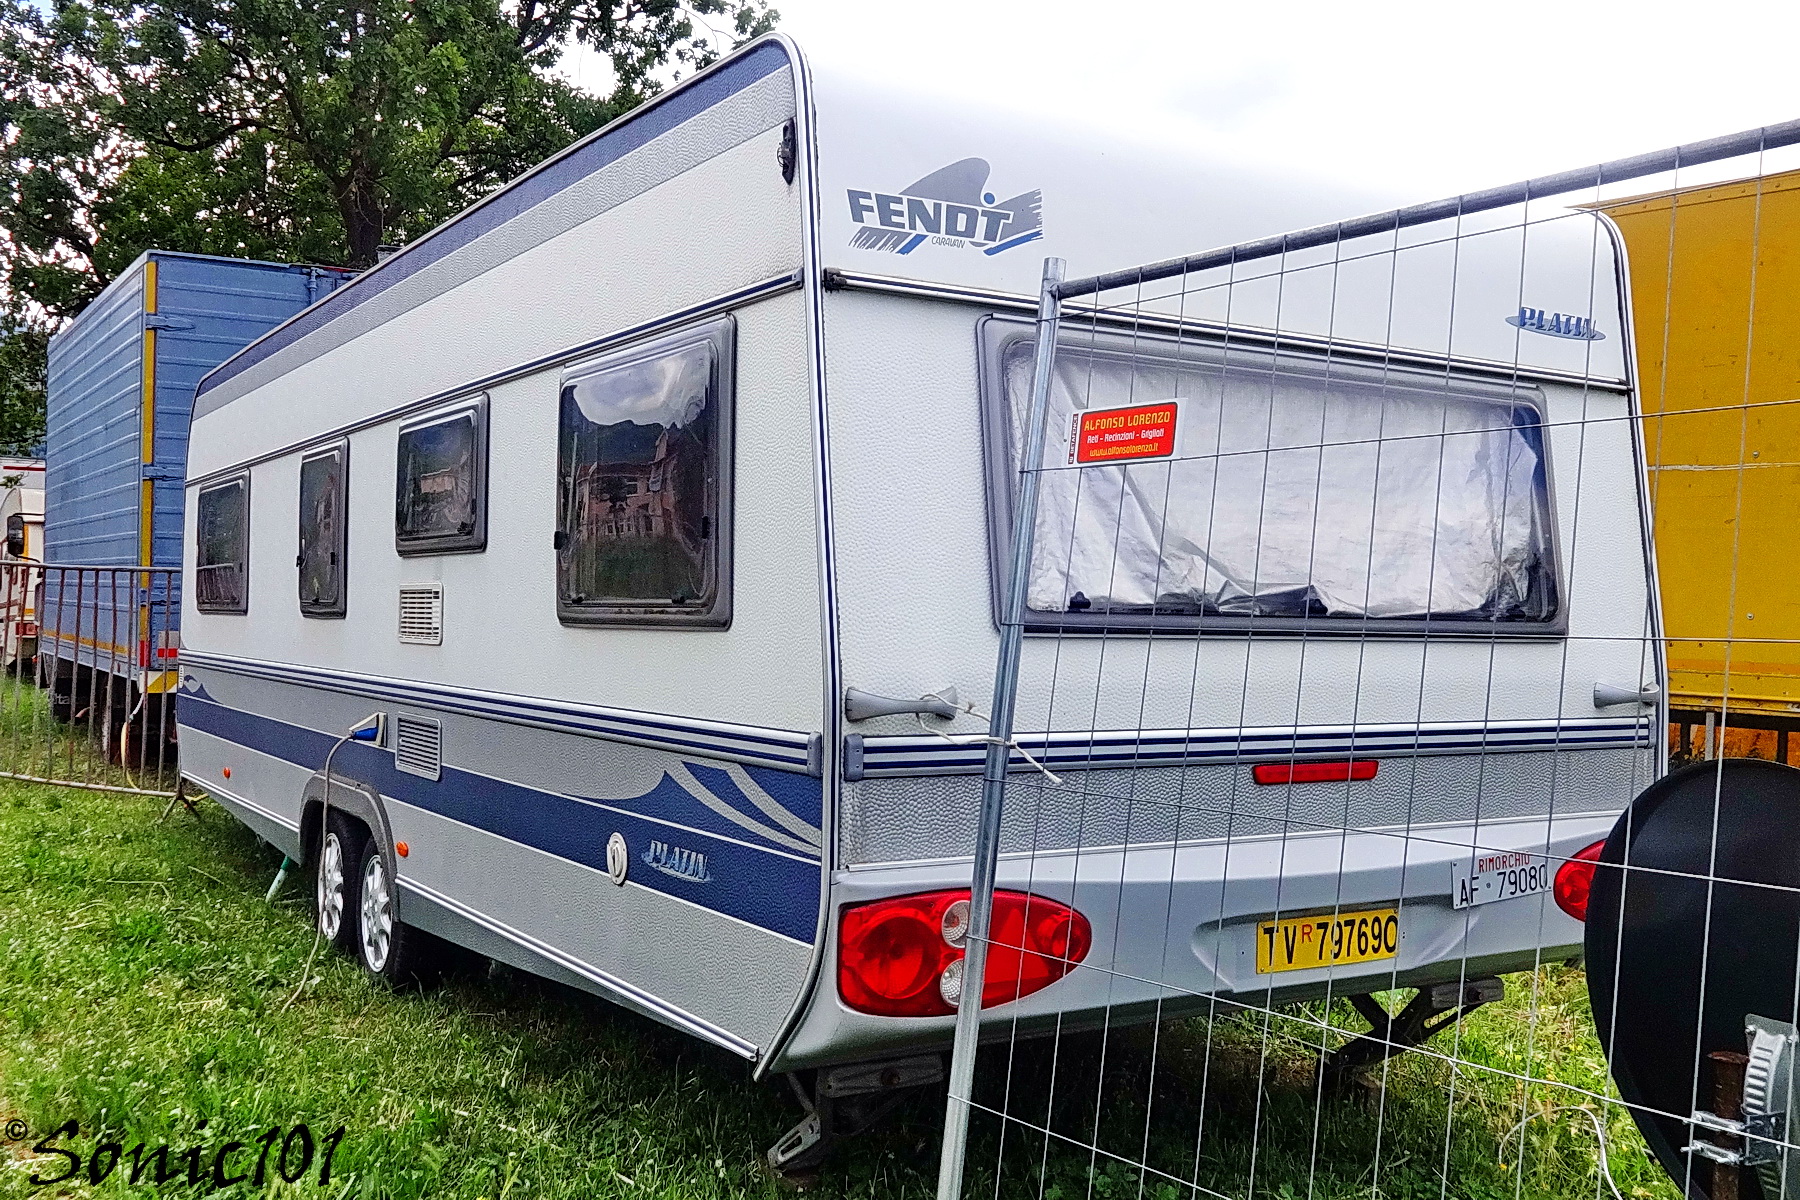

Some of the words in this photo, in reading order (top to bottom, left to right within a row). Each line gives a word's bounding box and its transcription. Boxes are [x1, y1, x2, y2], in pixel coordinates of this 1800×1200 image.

[847, 189, 1011, 242] FENDT
[932, 235, 965, 249] CARAVAN
[1520, 306, 1597, 338] PLATIN
[1084, 416, 1124, 431] ALFONSO
[1128, 411, 1170, 426] LORENZO
[648, 840, 708, 879] PLATIN
[1478, 852, 1531, 873] RIMORCHIO
[1460, 876, 1479, 905] AF
[1497, 864, 1548, 898] 79080
[1316, 914, 1398, 960] 797690
